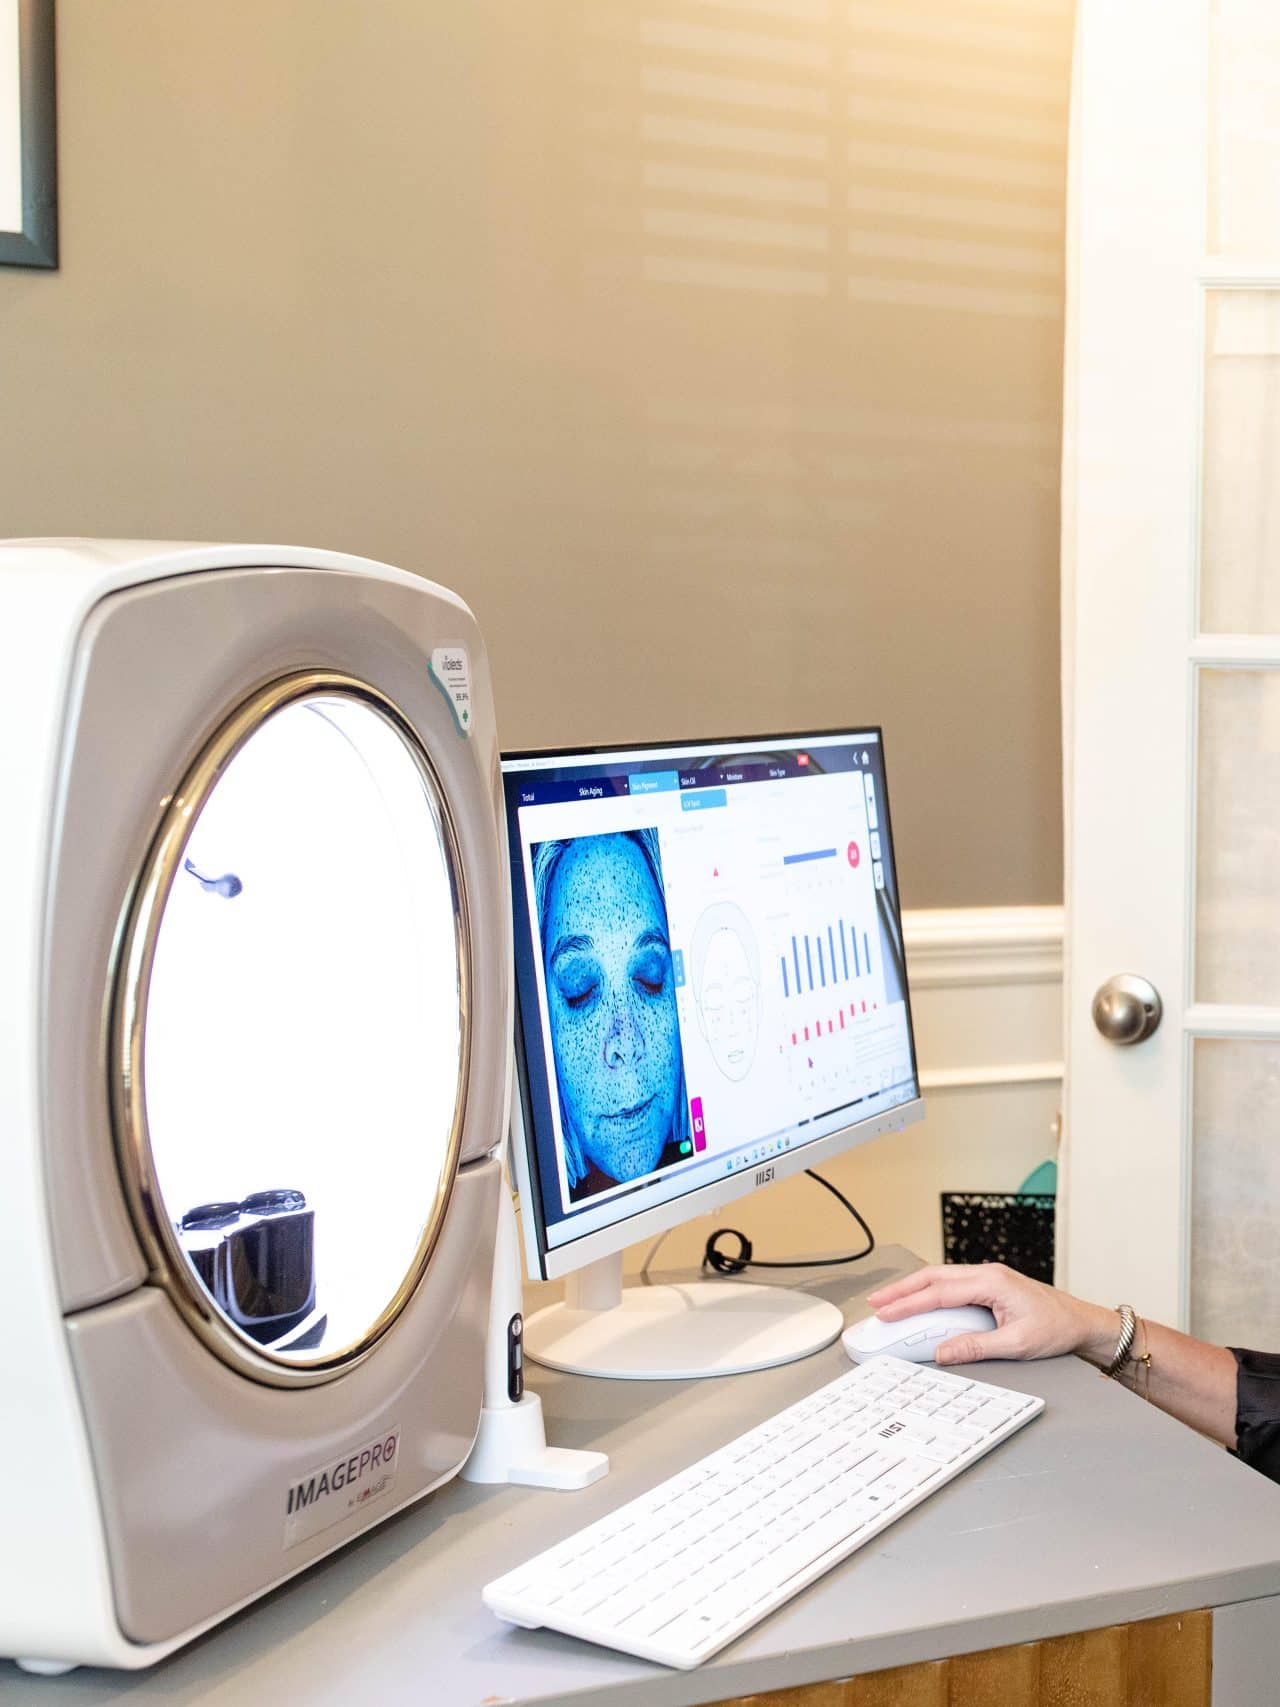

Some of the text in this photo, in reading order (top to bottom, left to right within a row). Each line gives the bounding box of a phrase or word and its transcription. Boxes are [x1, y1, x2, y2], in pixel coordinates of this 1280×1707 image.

[522, 792, 535, 802] Total
[579, 786, 603, 798] Skin Aging
[755, 1167, 775, 1186] MSI
[878, 1421, 906, 1439] MSI
